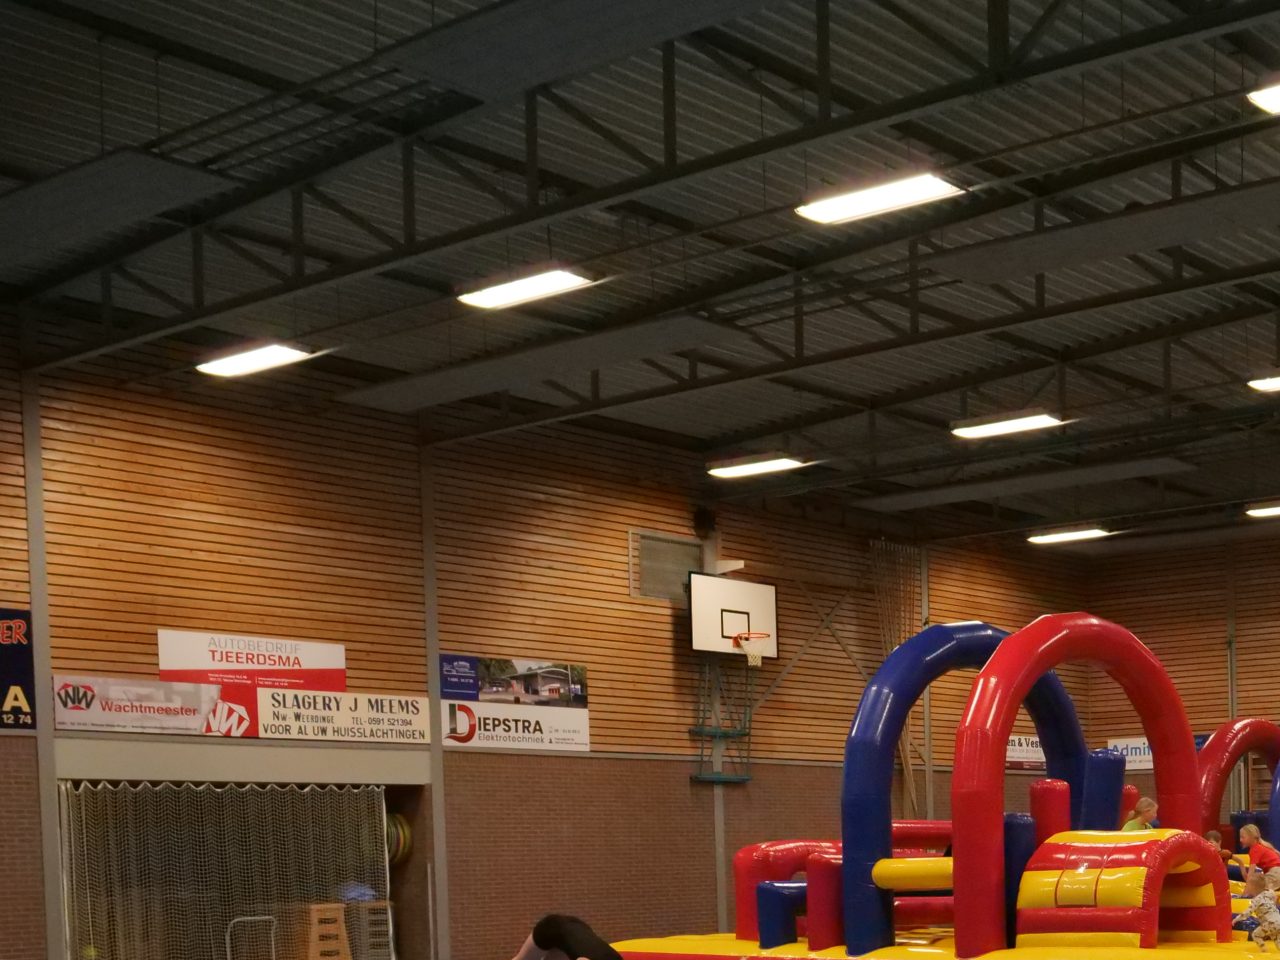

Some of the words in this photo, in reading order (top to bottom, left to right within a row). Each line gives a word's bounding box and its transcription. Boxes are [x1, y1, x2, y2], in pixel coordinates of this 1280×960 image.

[207, 637, 301, 654] AUTOBEDRIJF
[208, 650, 302, 668] TJEERDSMA
[100, 700, 198, 717] Wachtmeester
[271, 692, 343, 712] SLAGERY
[349, 697, 359, 712] J
[367, 698, 420, 716] MEEMS
[18, 714, 32, 724] 74
[262, 723, 291, 735] VOOR
[297, 725, 308, 736] AL
[312, 727, 328, 737] UW
[332, 727, 426, 740] HUISSLACHTINGEN
[478, 732, 545, 744] Elektrotechniek
[1018, 737, 1023, 748] &
